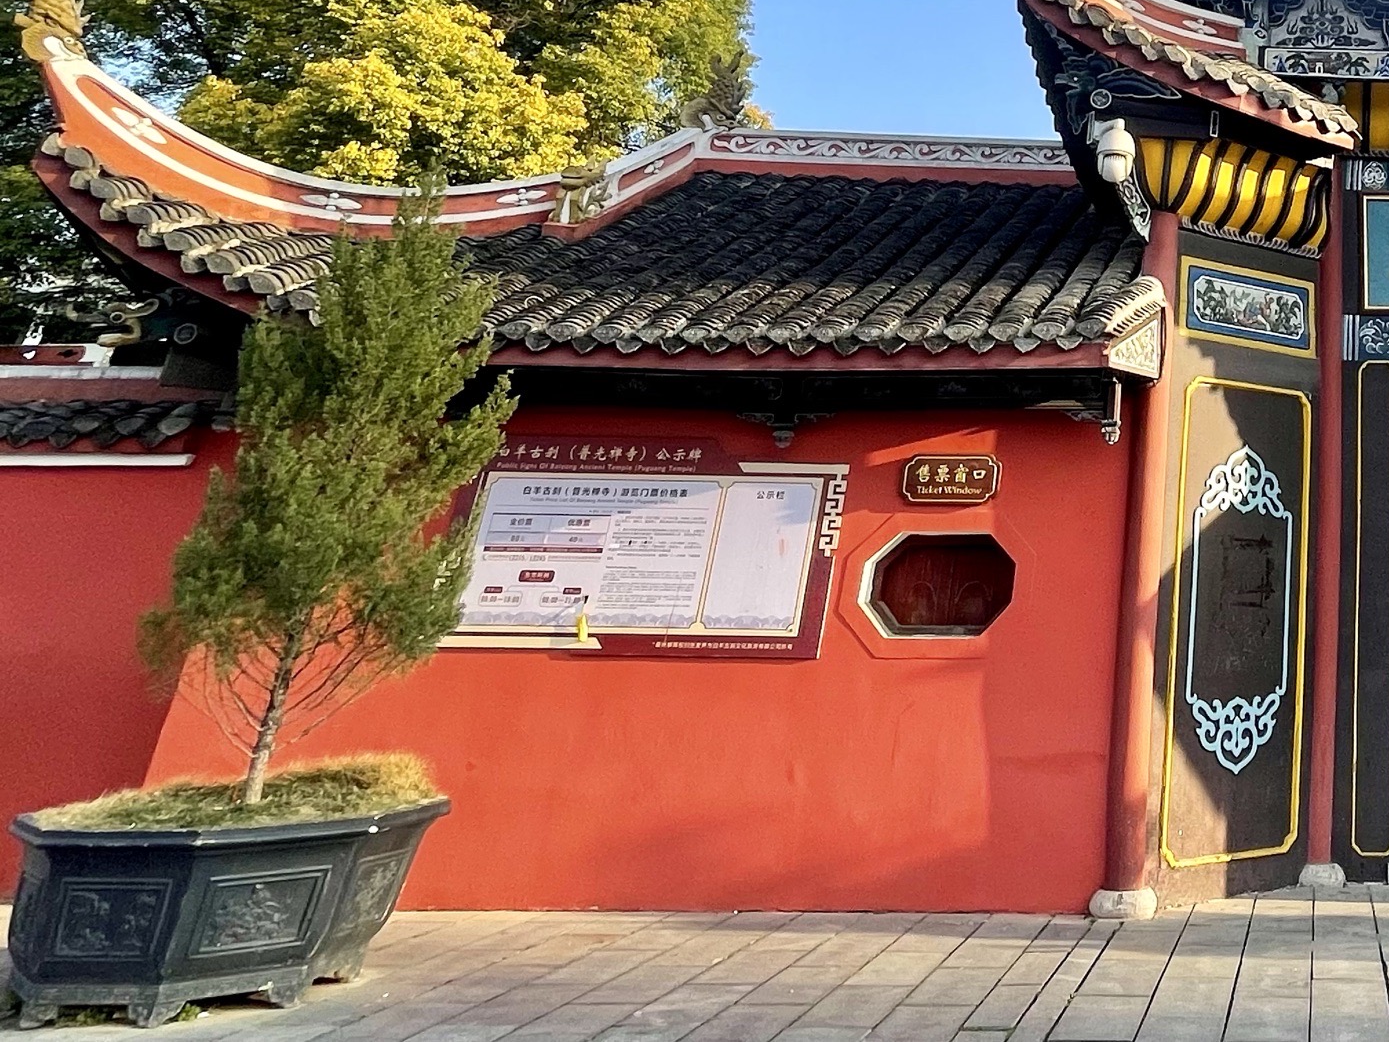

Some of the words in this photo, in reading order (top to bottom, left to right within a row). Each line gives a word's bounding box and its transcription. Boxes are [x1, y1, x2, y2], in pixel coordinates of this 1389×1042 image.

[916, 463, 987, 484] 售票窗口
[917, 485, 943, 495] Ticket
[944, 486, 983, 495] Window
